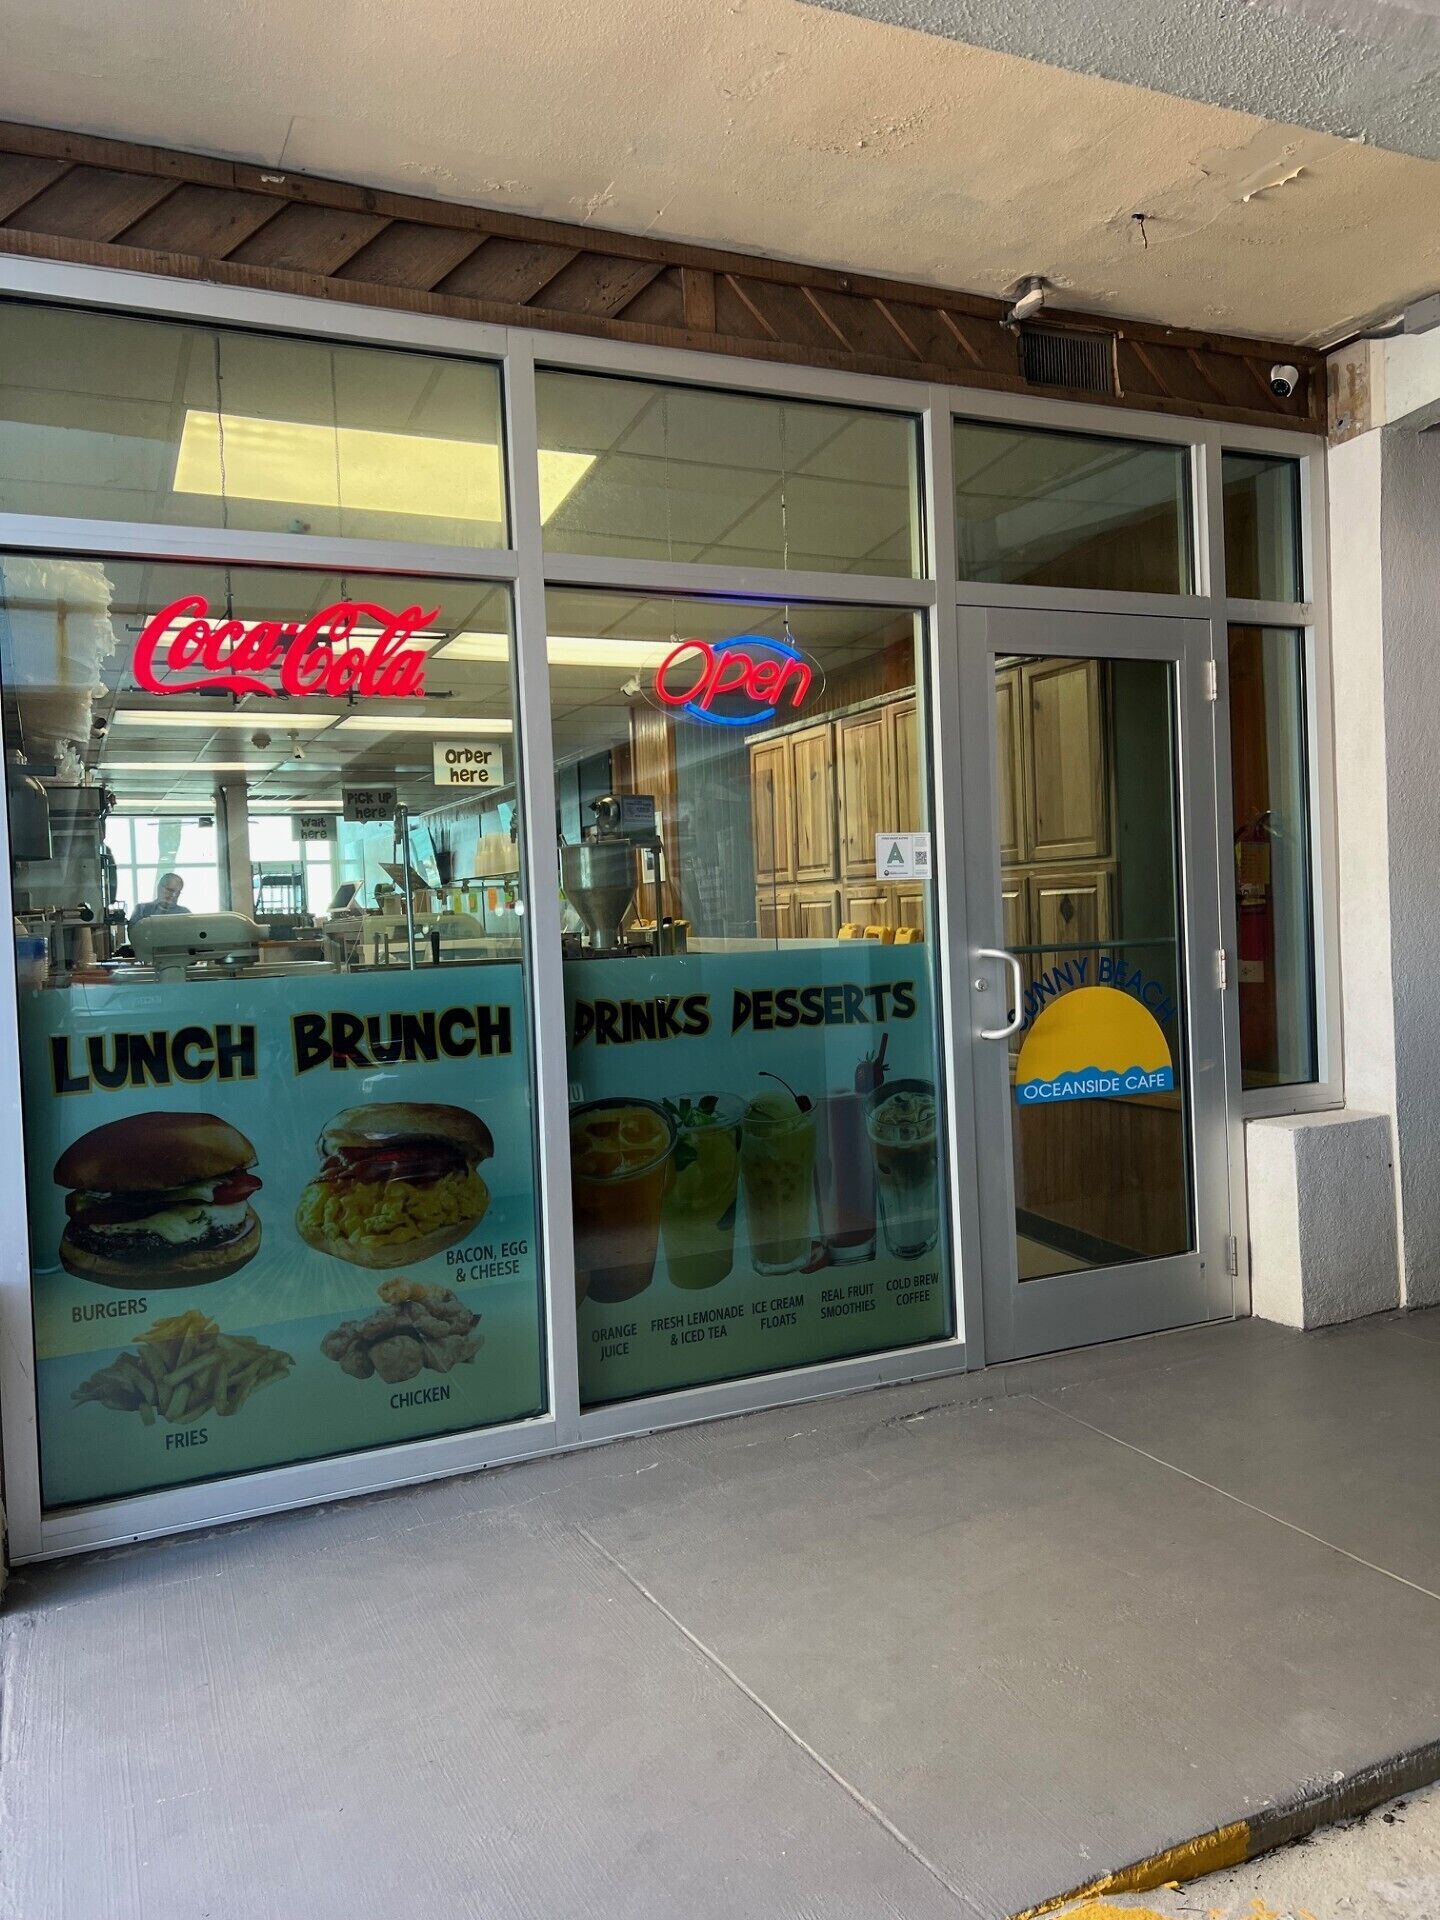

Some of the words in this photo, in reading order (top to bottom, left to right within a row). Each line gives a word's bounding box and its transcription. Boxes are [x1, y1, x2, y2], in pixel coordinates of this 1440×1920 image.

[133, 594, 441, 697] Coca-Cola
[656, 639, 812, 711] Open
[450, 767, 489, 783] here
[355, 806, 387, 819] here
[300, 828, 327, 839] here
[887, 842, 905, 864] A
[1099, 956, 1177, 1024] BEACH
[572, 993, 711, 1047] DRINKS
[731, 981, 917, 1038] DESSERTS
[290, 1006, 513, 1075] BRUNCH
[49, 1024, 257, 1096] LUNCH
[1023, 1077, 1120, 1099] OCEANSIDE
[1125, 1073, 1165, 1089] CAFE
[446, 1245, 498, 1267] BACON,
[502, 1240, 528, 1257] EGG
[456, 1268, 466, 1281] &
[470, 1261, 520, 1280] CHEESE
[886, 1277, 910, 1292] COLD
[914, 1272, 939, 1287] BREW
[821, 1289, 845, 1303] REAL
[847, 1283, 875, 1298] FRUIT
[896, 1290, 930, 1306] COFFEE
[71, 1298, 148, 1323] BURGERS
[752, 1301, 767, 1315] ICE
[770, 1294, 804, 1312] CREAM
[820, 1300, 876, 1319] SMOOTHIES
[651, 1314, 684, 1332] FRESH
[687, 1304, 745, 1326] LEMONADE
[760, 1312, 797, 1330] FLOATS
[591, 1323, 638, 1344] ORANGE
[670, 1333, 678, 1346] &
[681, 1329, 705, 1344] ICED
[708, 1325, 728, 1339] TEA
[600, 1342, 629, 1362] JUICE
[390, 1386, 450, 1409] CHICKEN
[165, 1428, 208, 1450] FRIES
